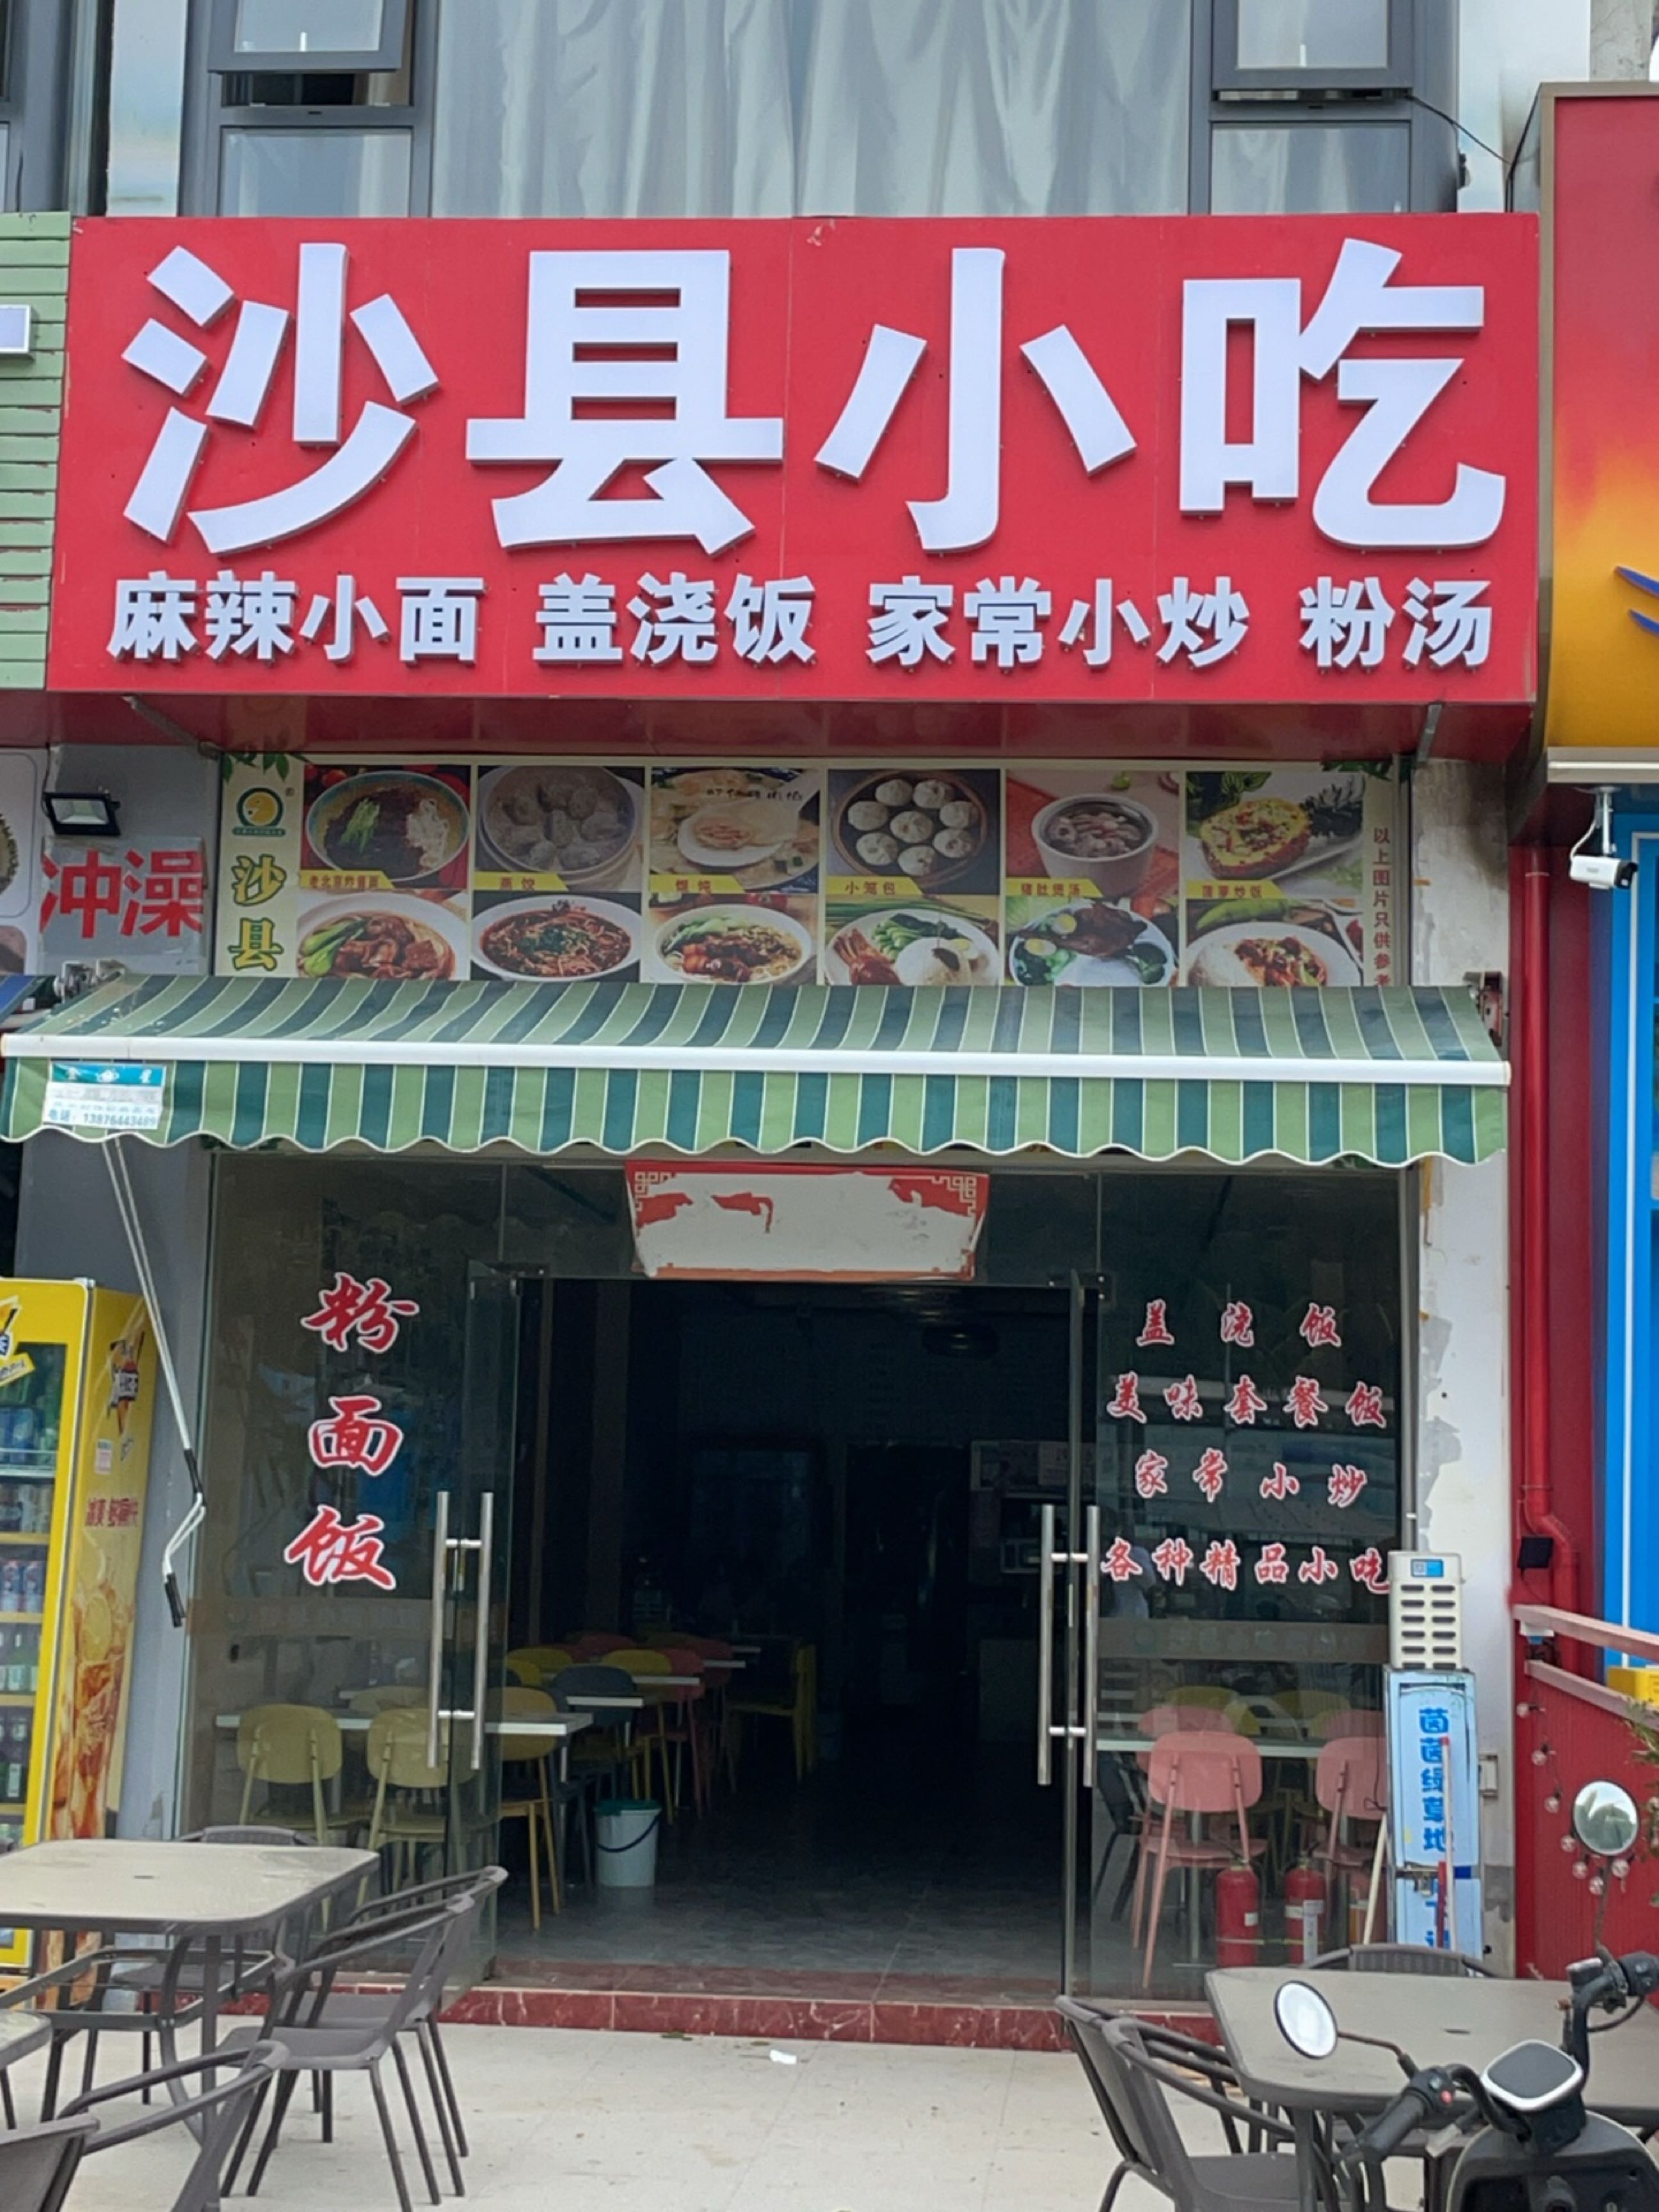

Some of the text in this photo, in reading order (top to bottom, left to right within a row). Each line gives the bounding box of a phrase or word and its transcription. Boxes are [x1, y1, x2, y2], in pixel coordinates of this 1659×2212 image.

[122, 237, 1507, 556] 沙县小吃
[107, 569, 1493, 668] 麻辣小面 盖浇饭 家常小炒 粉汤
[40, 849, 204, 939] 冲澡
[227, 853, 287, 972] 沙县
[845, 880, 895, 895] 小笼包
[1137, 1299, 1342, 1347] 盖浇饭
[285, 1272, 419, 1591] 粉面饭
[1107, 1371, 1386, 1429] 美味套餐饭
[1135, 1448, 1367, 1507] 家常小炒
[1101, 1536, 1390, 1594] 各种精品小吃
